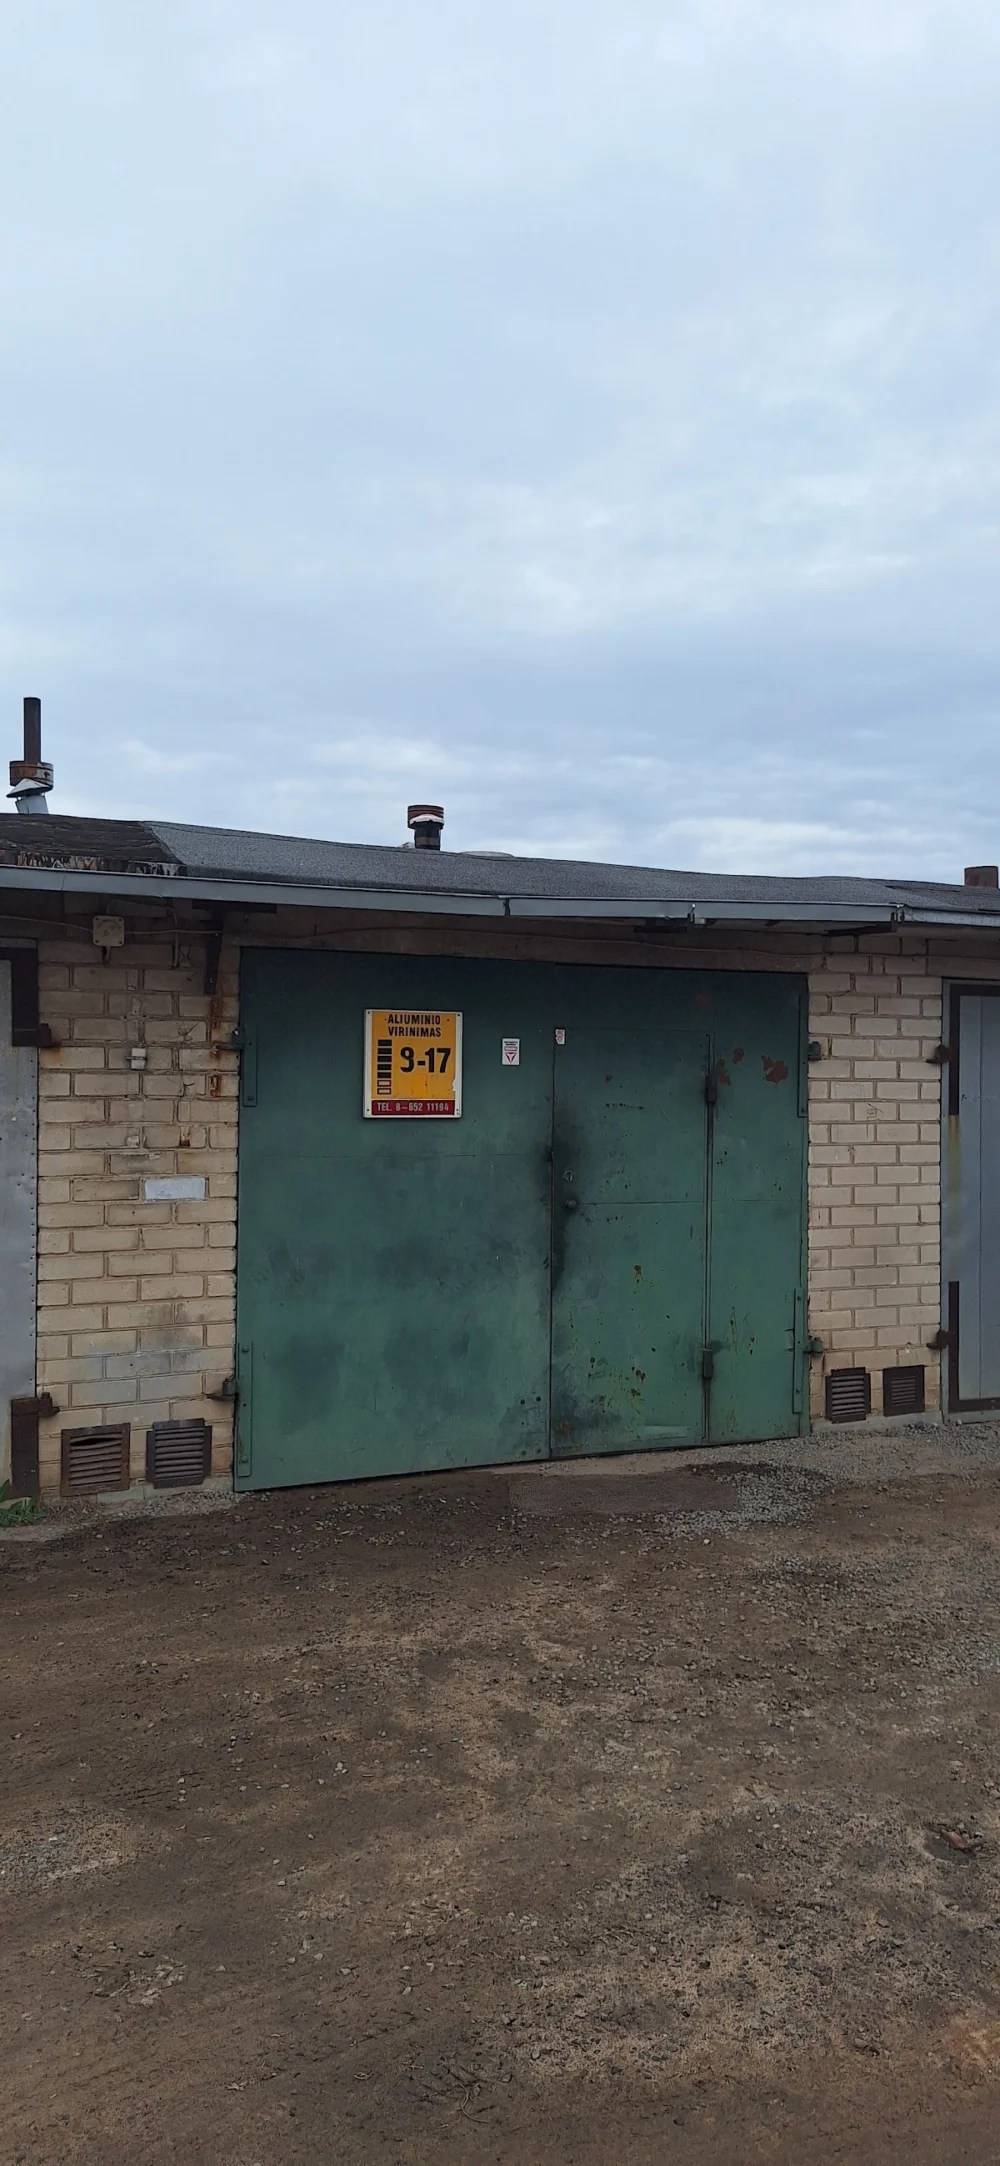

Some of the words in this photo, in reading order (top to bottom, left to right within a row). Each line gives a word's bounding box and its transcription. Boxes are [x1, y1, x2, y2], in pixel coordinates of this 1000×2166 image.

[388, 1014, 440, 1025] ALIUMINIO
[388, 1026, 441, 1037] VIRINIMAS
[400, 1046, 451, 1073] 9-17
[377, 1102, 392, 1112] TEL.
